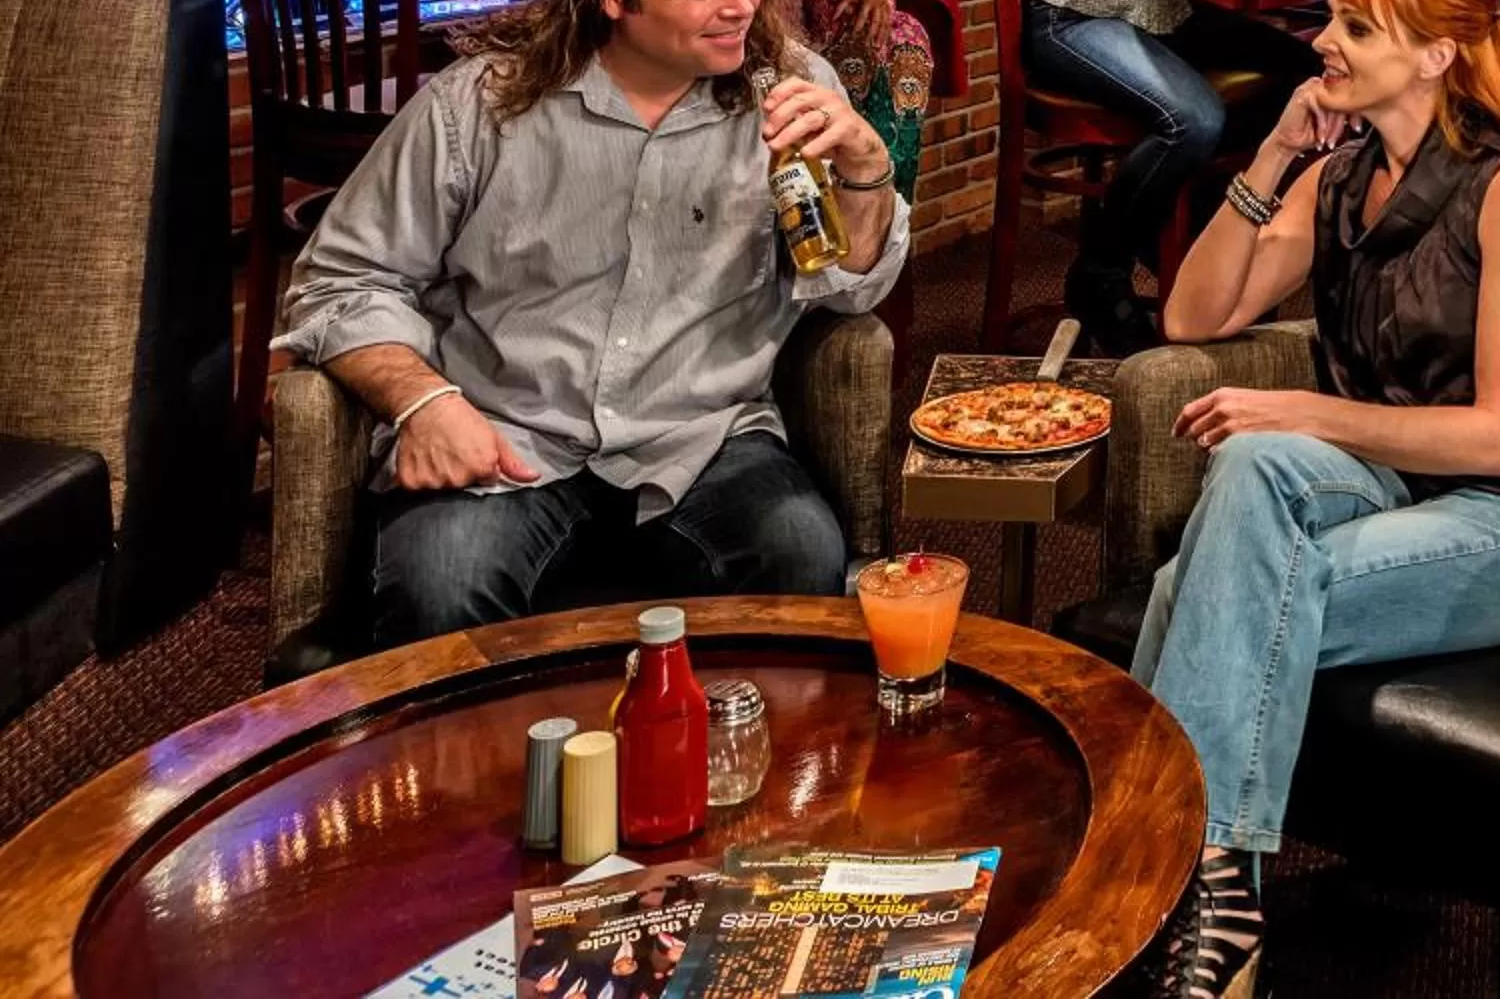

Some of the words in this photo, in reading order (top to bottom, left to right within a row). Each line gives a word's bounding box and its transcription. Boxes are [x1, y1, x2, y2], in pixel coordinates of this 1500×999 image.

[768, 900, 848, 913] GAMING
[854, 903, 921, 914] TRIBAL
[719, 909, 960, 929] DREAMCATCHERS
[647, 920, 682, 936] the
